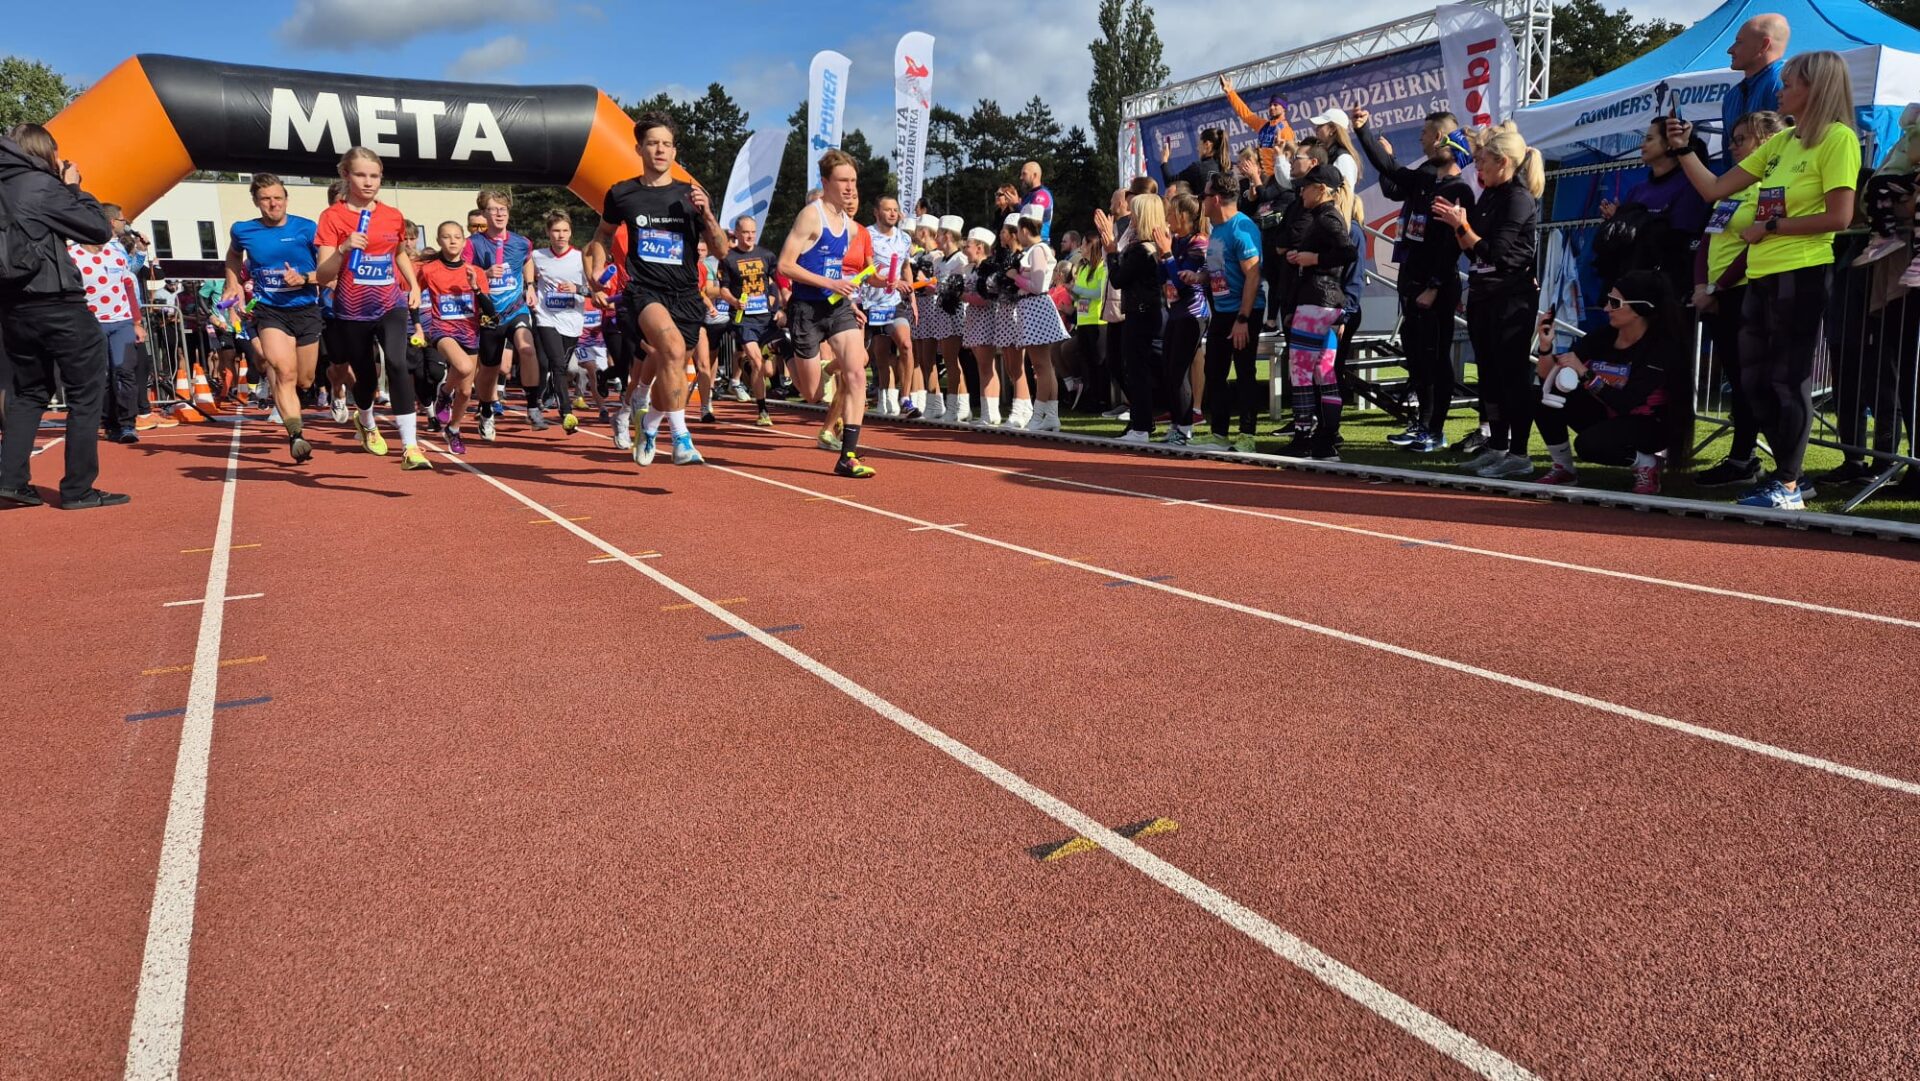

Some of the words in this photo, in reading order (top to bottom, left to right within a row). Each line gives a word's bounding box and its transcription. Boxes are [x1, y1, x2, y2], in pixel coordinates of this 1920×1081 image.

[818, 69, 837, 136] POWER
[1288, 100, 1312, 123] 20
[1575, 94, 1652, 127] RUNNER'S
[269, 88, 512, 162] META
[642, 241, 665, 254] 24/1
[357, 264, 382, 277] 67/1
